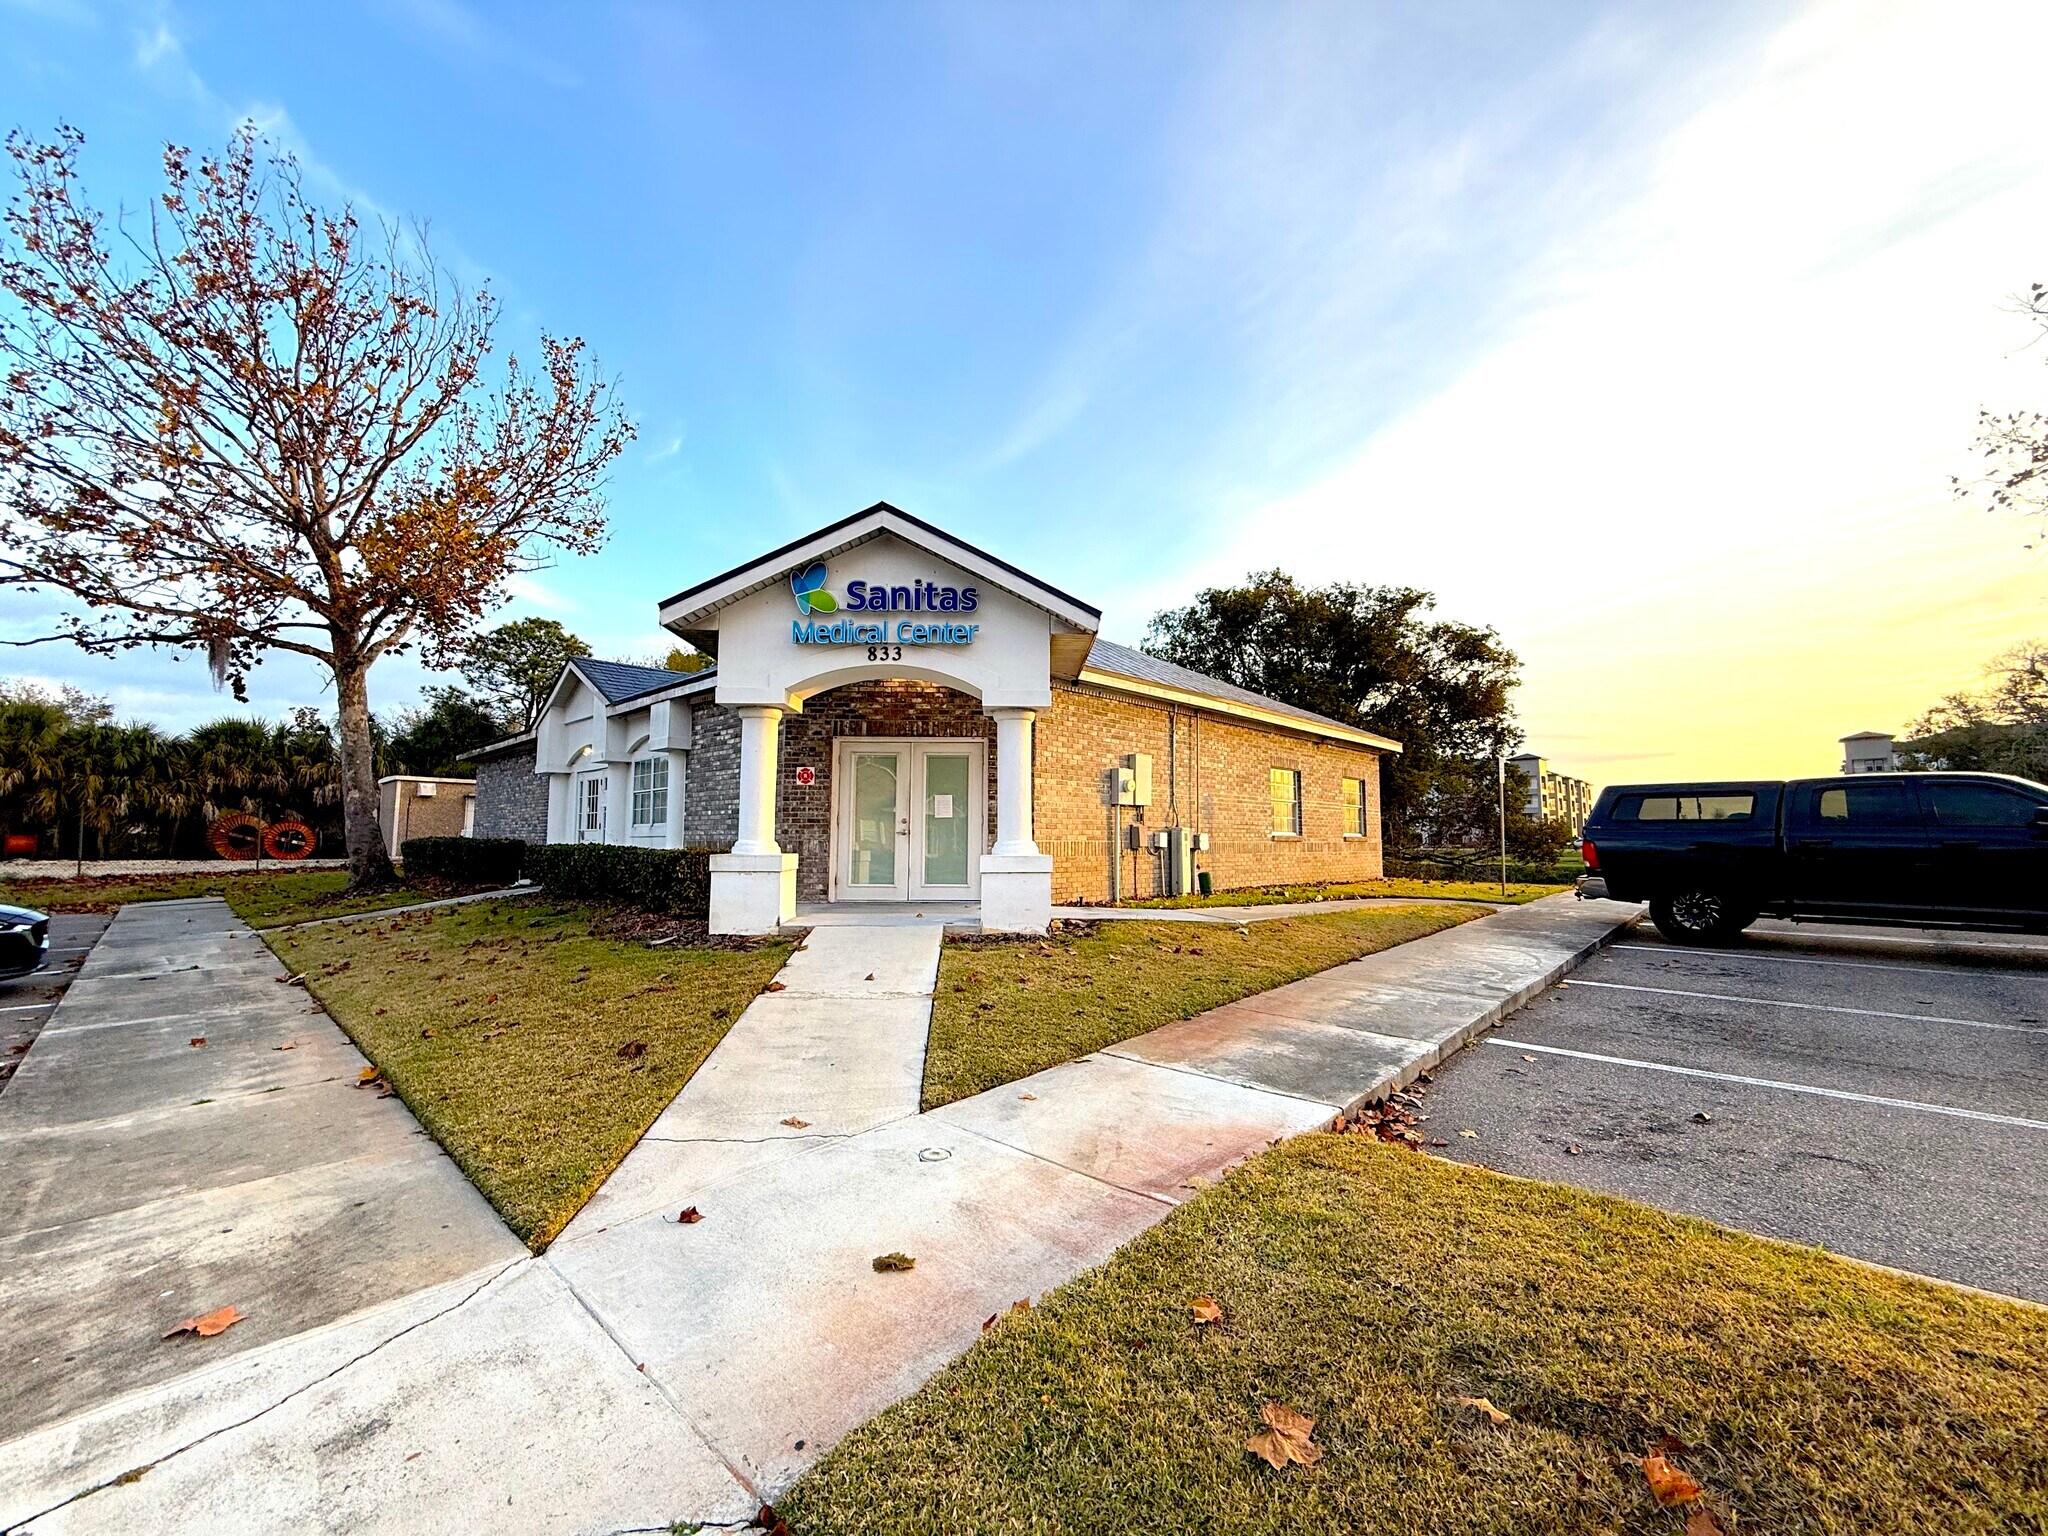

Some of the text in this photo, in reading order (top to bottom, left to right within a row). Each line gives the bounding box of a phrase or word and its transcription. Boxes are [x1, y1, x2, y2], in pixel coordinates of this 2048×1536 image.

[846, 579, 978, 612] Sanitas
[792, 619, 979, 644] Medical Center
[867, 646, 902, 661] 833
